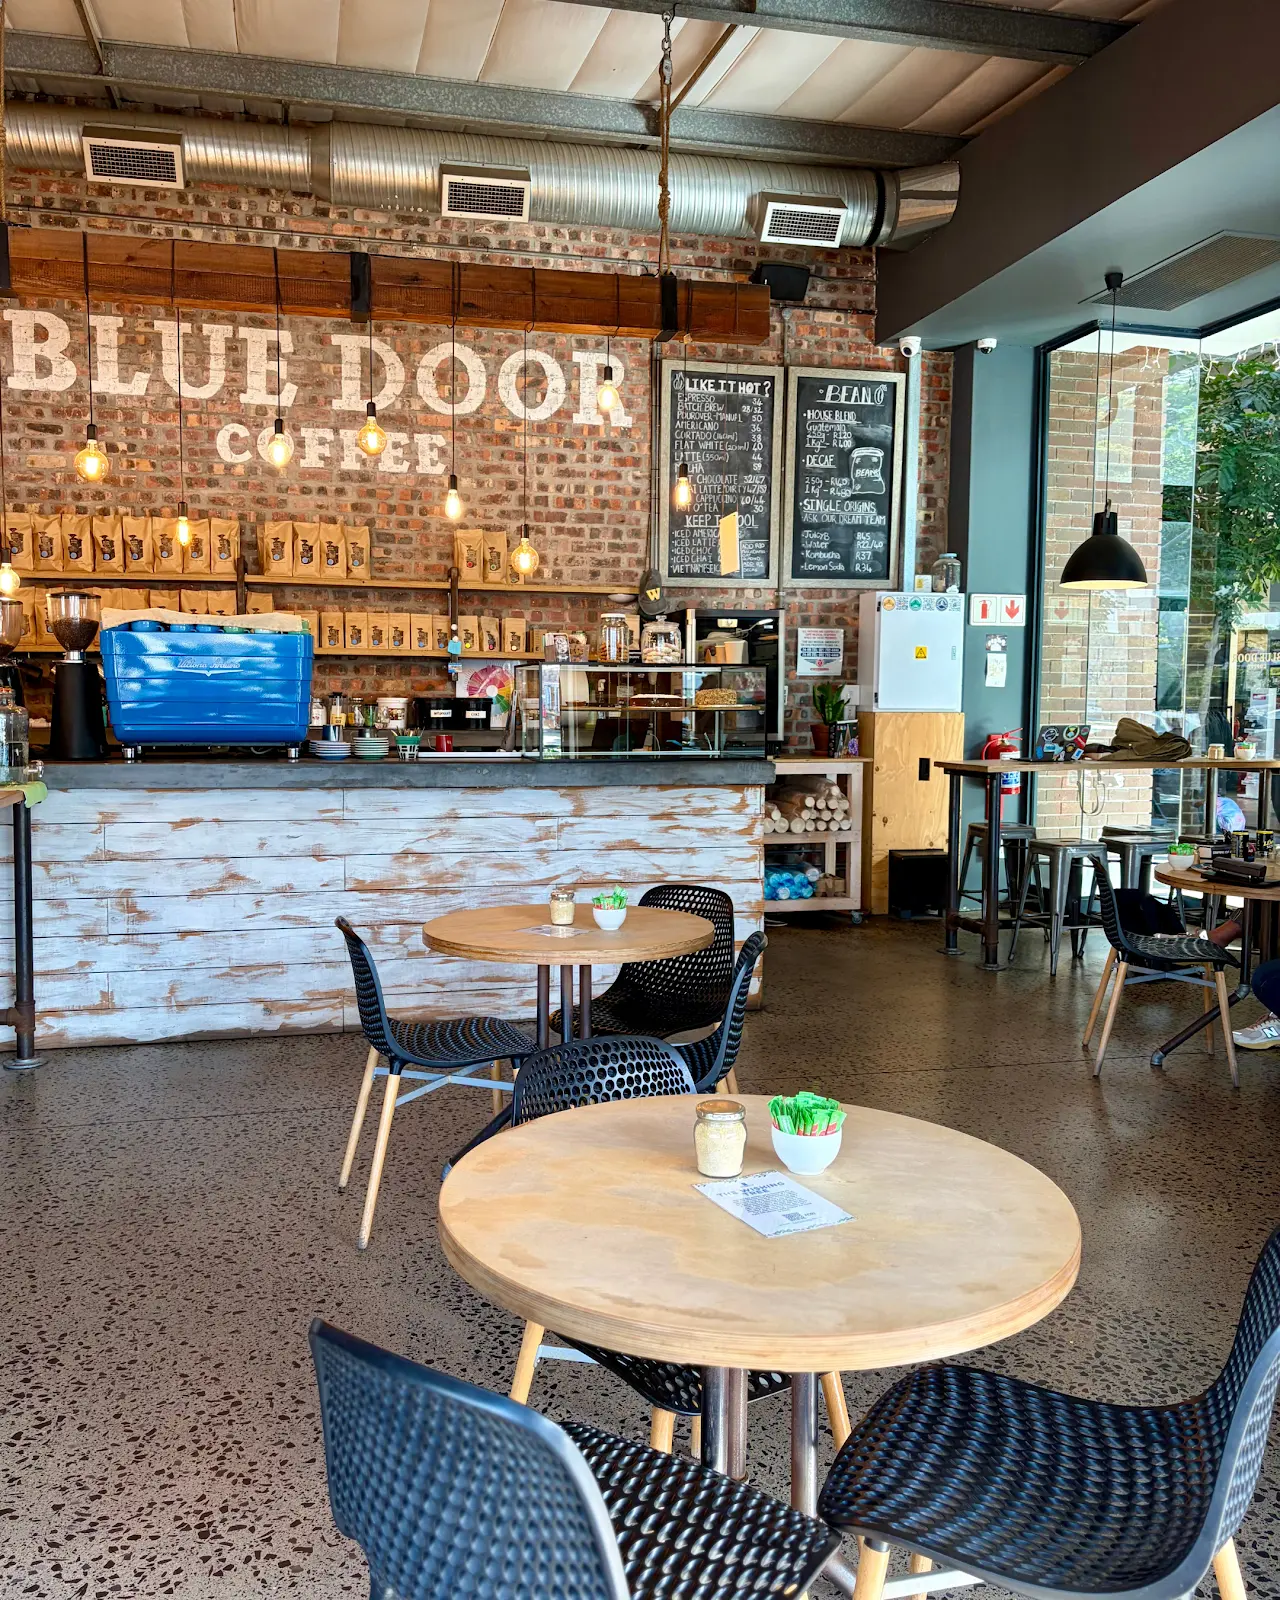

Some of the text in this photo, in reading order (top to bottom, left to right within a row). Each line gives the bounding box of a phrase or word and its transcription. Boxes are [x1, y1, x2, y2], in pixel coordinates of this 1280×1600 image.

[3, 309, 633, 428] BLUE DOOR
[685, 378, 715, 391] LIKE
[718, 380, 736, 393] IT
[739, 382, 761, 395] HOT
[678, 393, 763, 406] ESPRESSO 34
[678, 403, 702, 411] BATCH
[807, 410, 856, 421] HOUSE BLEND
[675, 422, 761, 432] AMERICANO 36
[806, 422, 846, 432] Guatemala
[675, 430, 711, 440] CORTADO
[751, 434, 761, 442] 38
[216, 423, 447, 474] COFFEE
[675, 441, 694, 450] FLAT
[699, 441, 724, 450] WHITE
[752, 443, 763, 451] 40
[832, 439, 852, 448] R400
[675, 452, 701, 461] LATTE
[806, 455, 834, 466] DECAF
[674, 462, 762, 474] MCHA 59
[675, 474, 765, 484] HT CHOCOLATE 32/47
[805, 477, 823, 488] 250g
[805, 485, 819, 497] 1Kg
[696, 495, 765, 505] CAPPUCCINO 40/44
[803, 499, 876, 512] SINGLE ORIGINS
[754, 505, 763, 513] 30
[685, 514, 711, 527] KEEP
[803, 514, 886, 525] ASK OUR DREAM TEAM
[675, 530, 691, 538] ICED
[805, 540, 883, 549] Water R22/40
[691, 547, 712, 555] CHOC
[805, 550, 872, 560] Kombucha R37
[691, 555, 712, 563] CHAI
[804, 561, 872, 572] Lemon Soda R34
[645, 587, 661, 602] W
[1262, 1027, 1279, 1038] N
